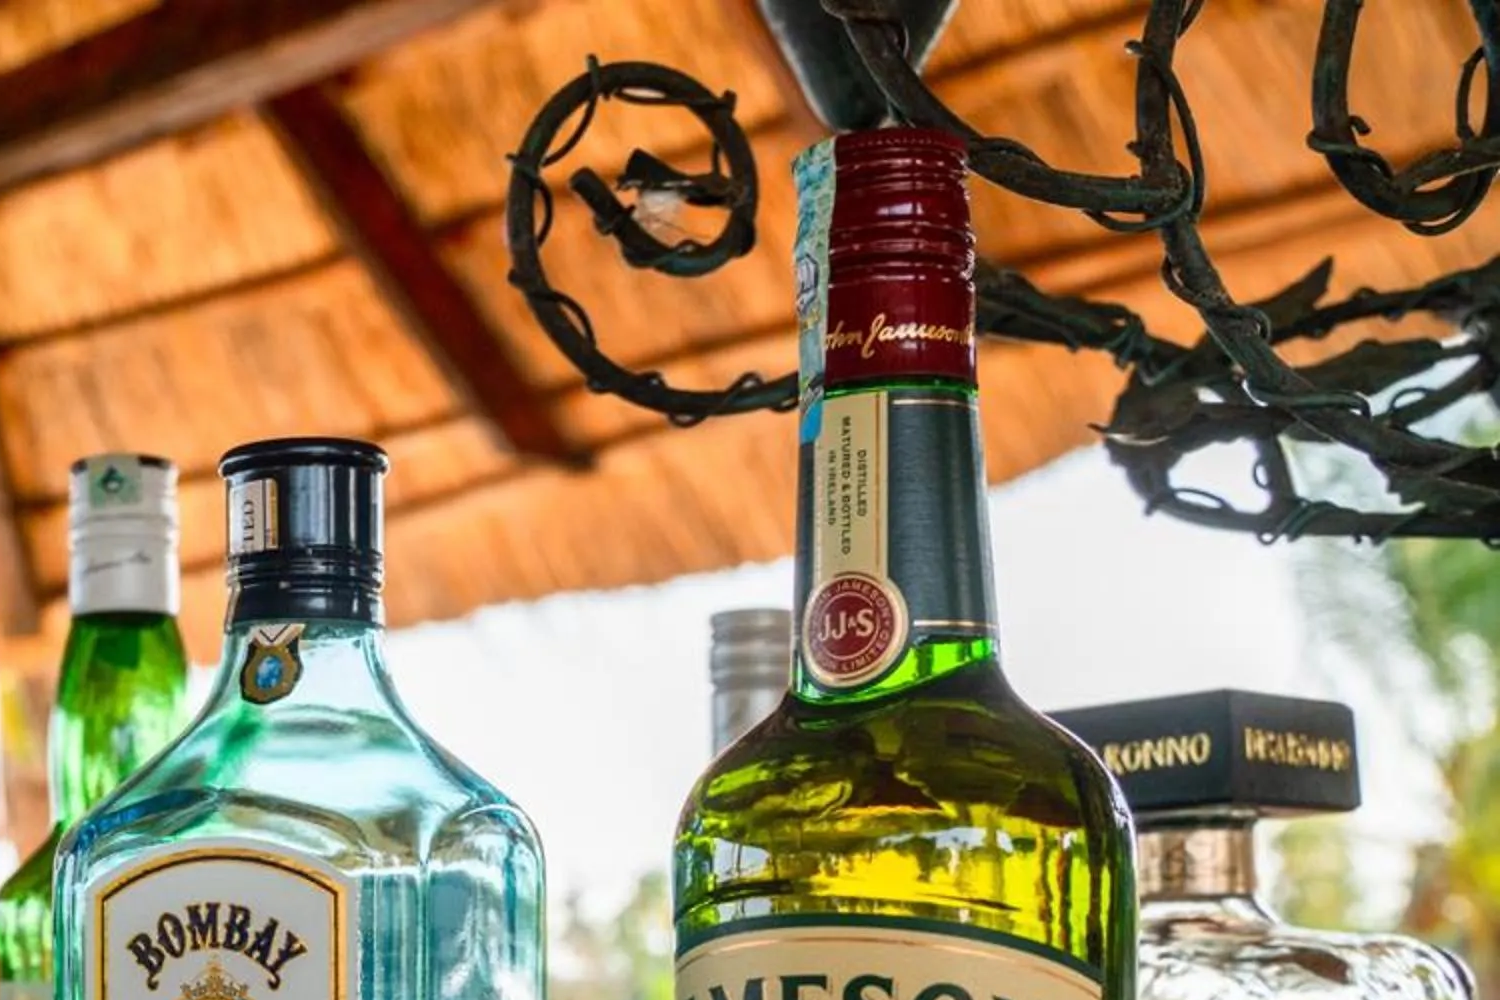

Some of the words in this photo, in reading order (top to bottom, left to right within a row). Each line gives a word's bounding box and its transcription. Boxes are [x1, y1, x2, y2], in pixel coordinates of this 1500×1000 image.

[841, 416, 851, 479] MATURED
[828, 468, 837, 526] IRELAND
[857, 449, 867, 517] DISTILLED
[841, 494, 851, 556] BOTTLED
[126, 902, 307, 991] BOMBAY
